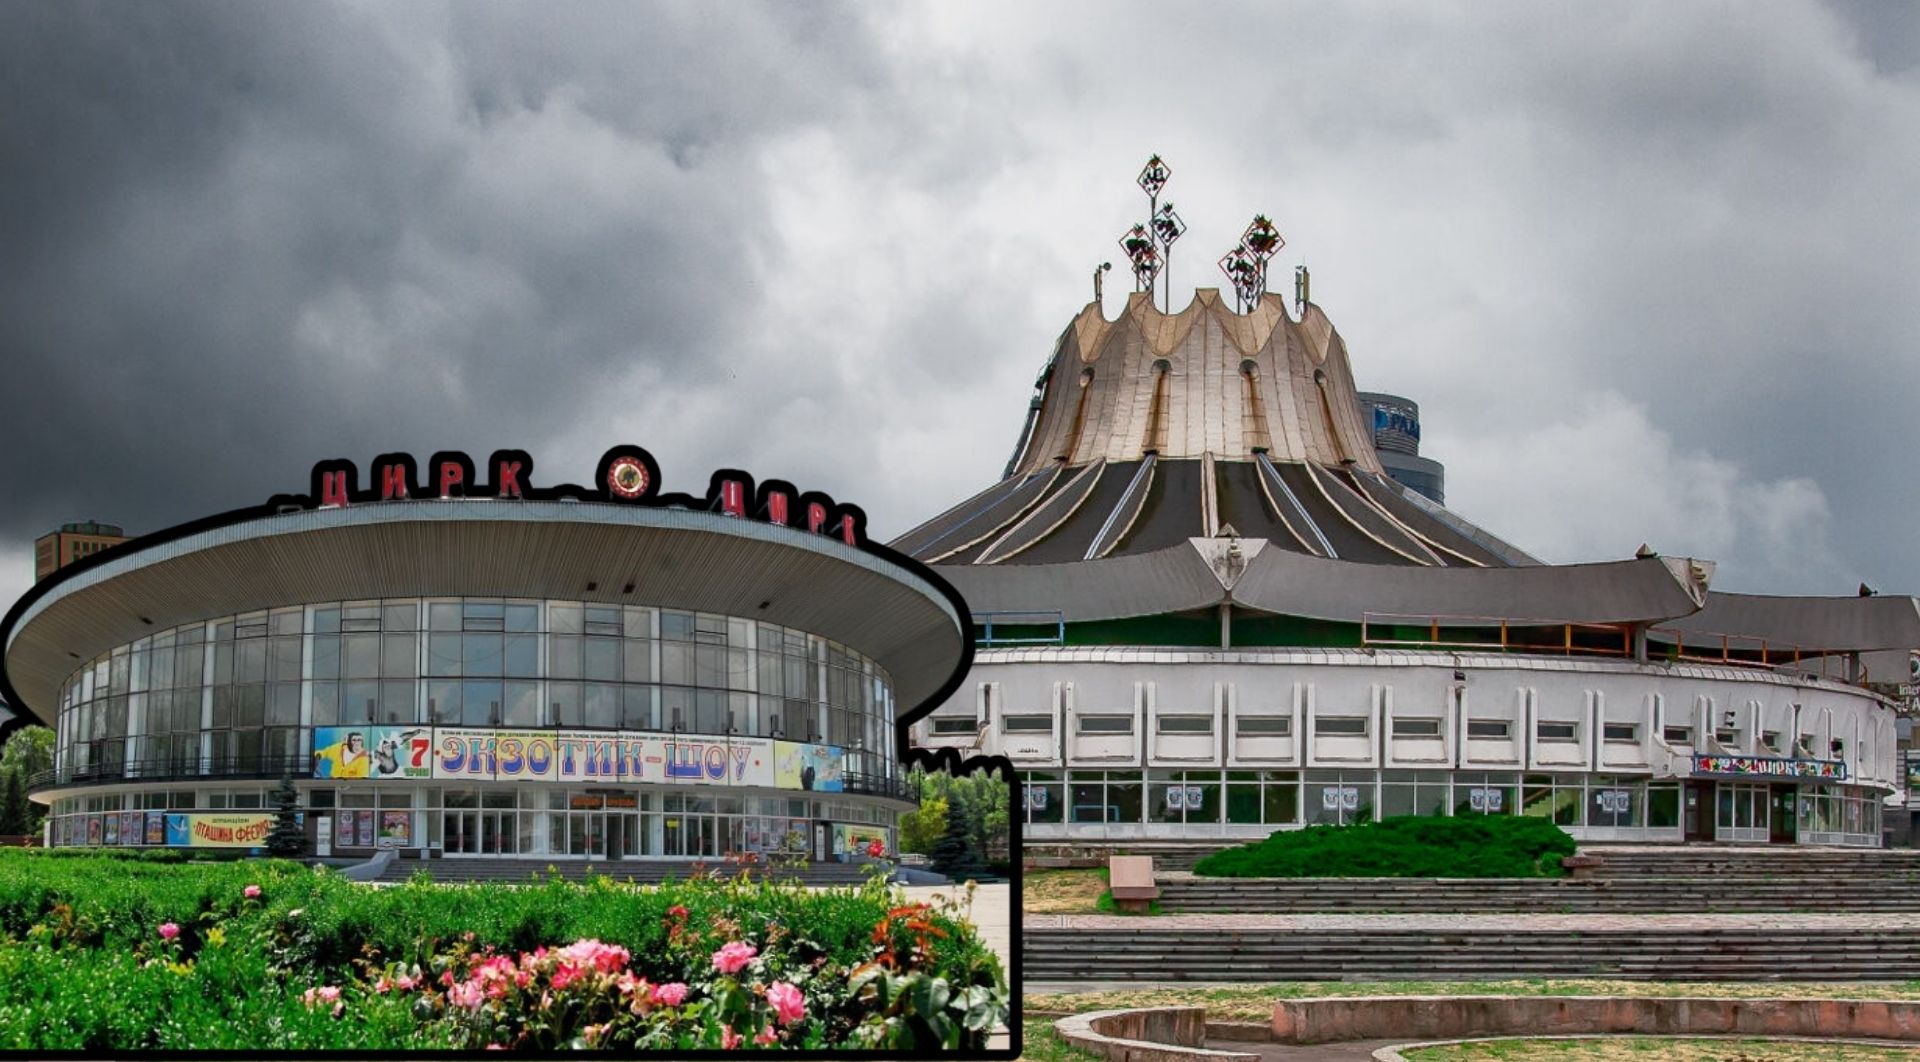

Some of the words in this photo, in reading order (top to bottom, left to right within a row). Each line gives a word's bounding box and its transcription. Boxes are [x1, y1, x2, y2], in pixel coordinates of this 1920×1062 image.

[322, 461, 522, 507] ЦИРК
[722, 479, 856, 547] ЦИРК
[411, 738, 430, 767] 7
